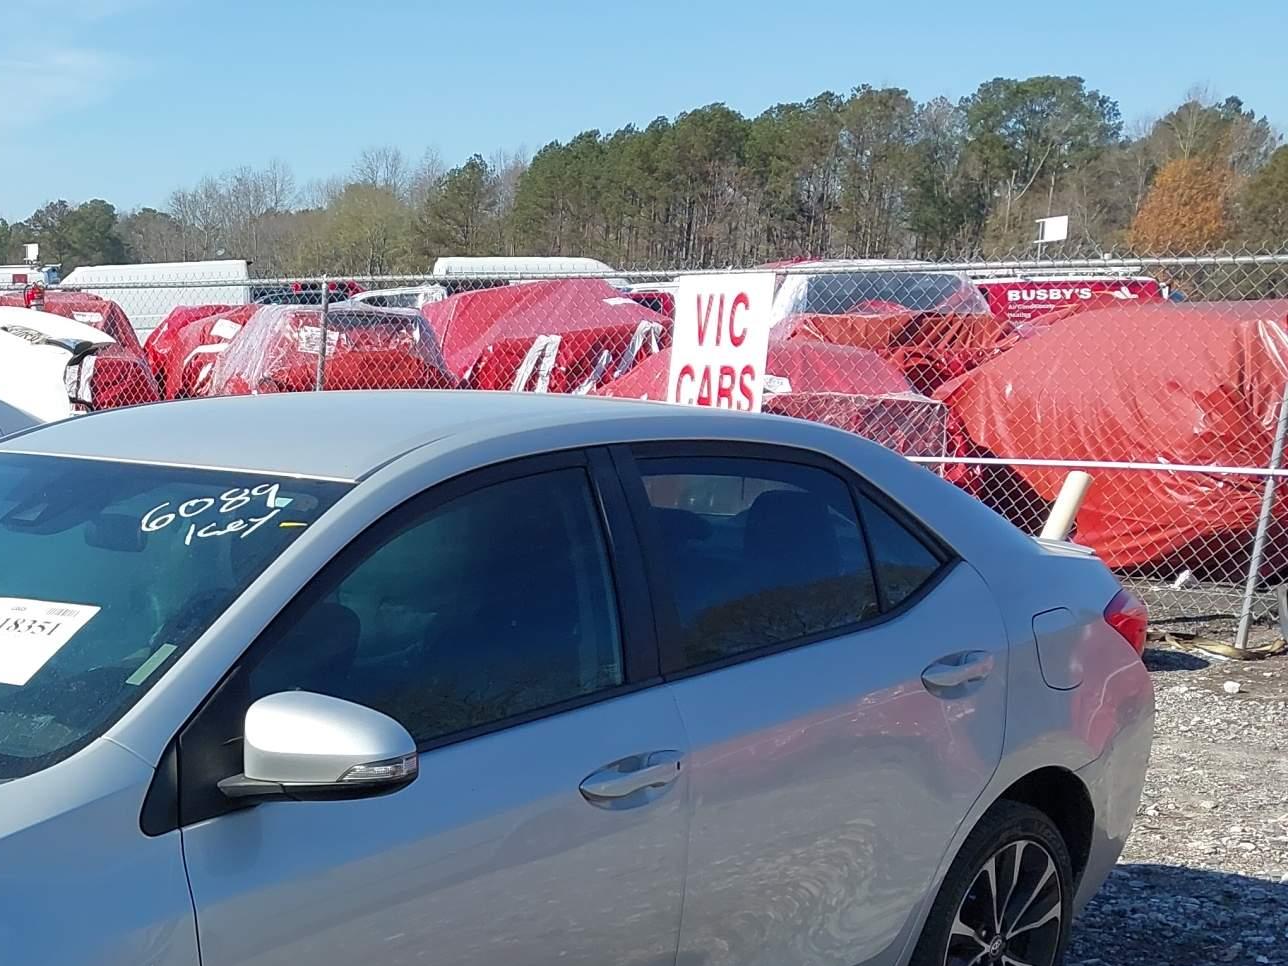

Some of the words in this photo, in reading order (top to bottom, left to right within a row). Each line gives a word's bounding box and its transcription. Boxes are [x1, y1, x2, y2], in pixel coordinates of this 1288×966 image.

[1007, 288, 1092, 301] BUSBY'S
[696, 292, 750, 348] VIC
[675, 364, 756, 412] CARS
[141, 483, 280, 532] 6089
